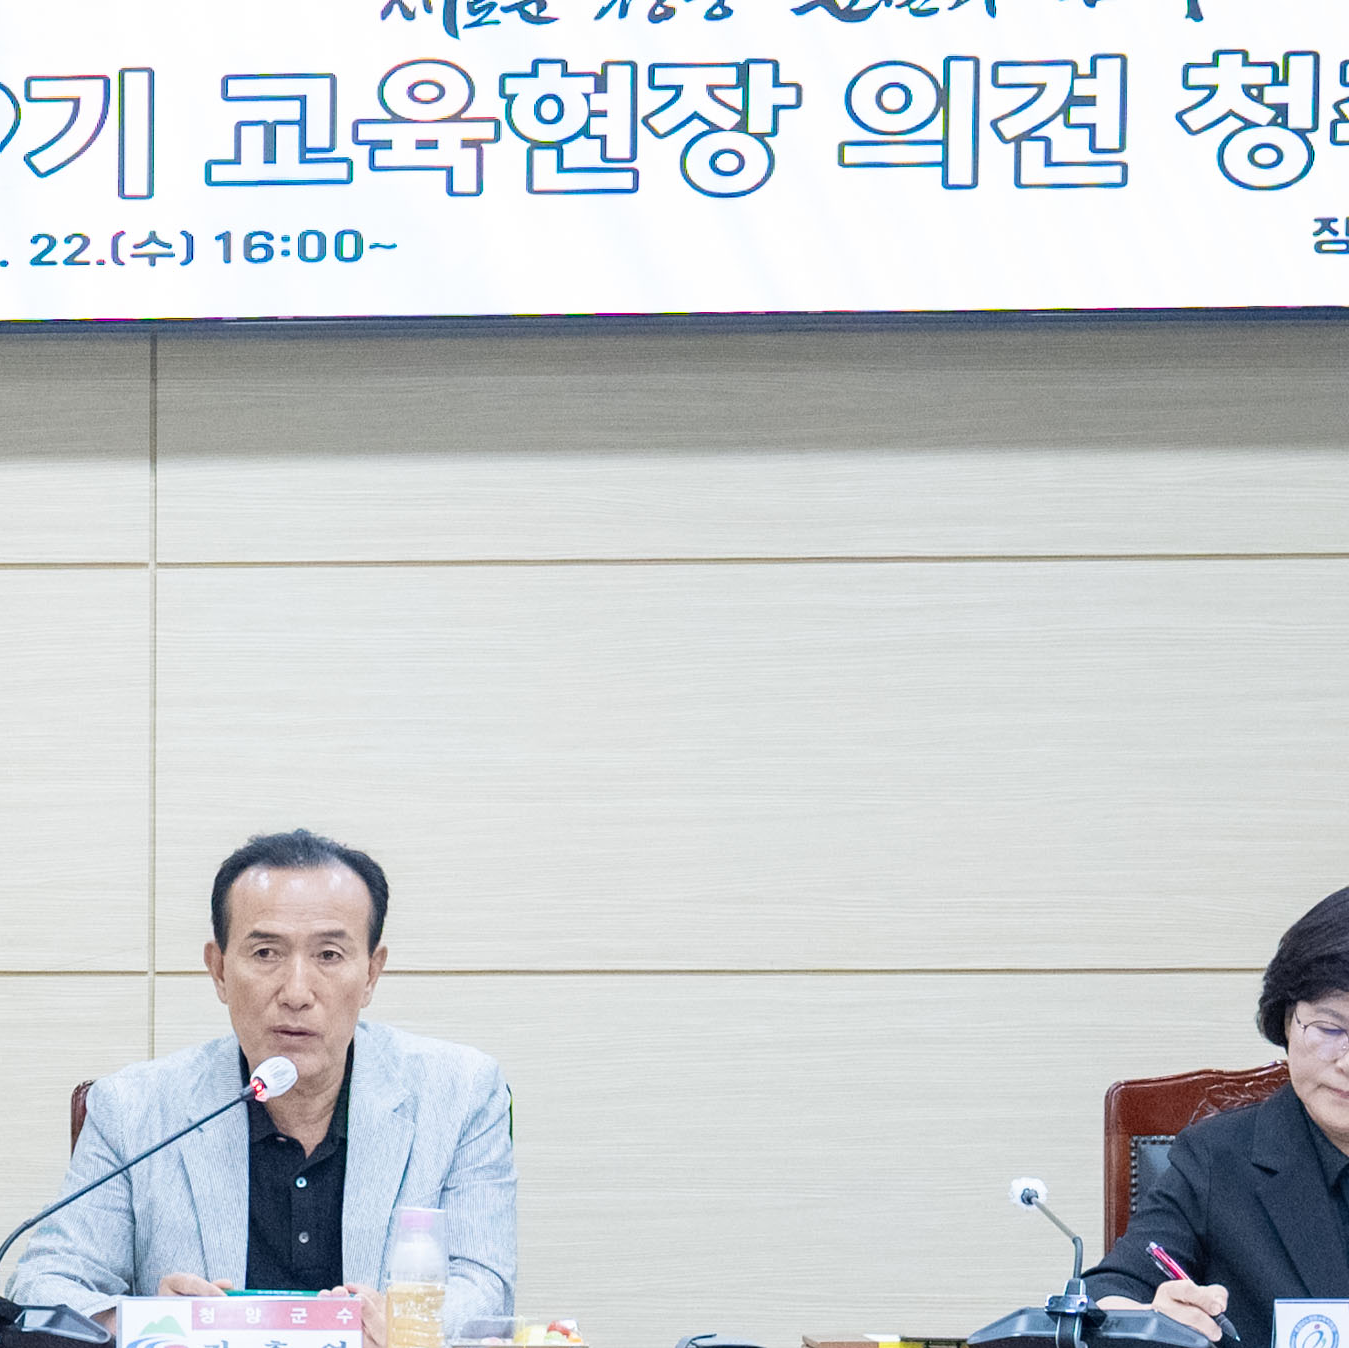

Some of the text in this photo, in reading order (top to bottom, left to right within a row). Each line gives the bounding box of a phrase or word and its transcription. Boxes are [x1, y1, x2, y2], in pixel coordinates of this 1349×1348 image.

[204, 57, 803, 199] 교육현장
[837, 53, 1129, 191] 의견
[29, 229, 195, 268] 22.(수)
[214, 229, 398, 265] 16:00~
